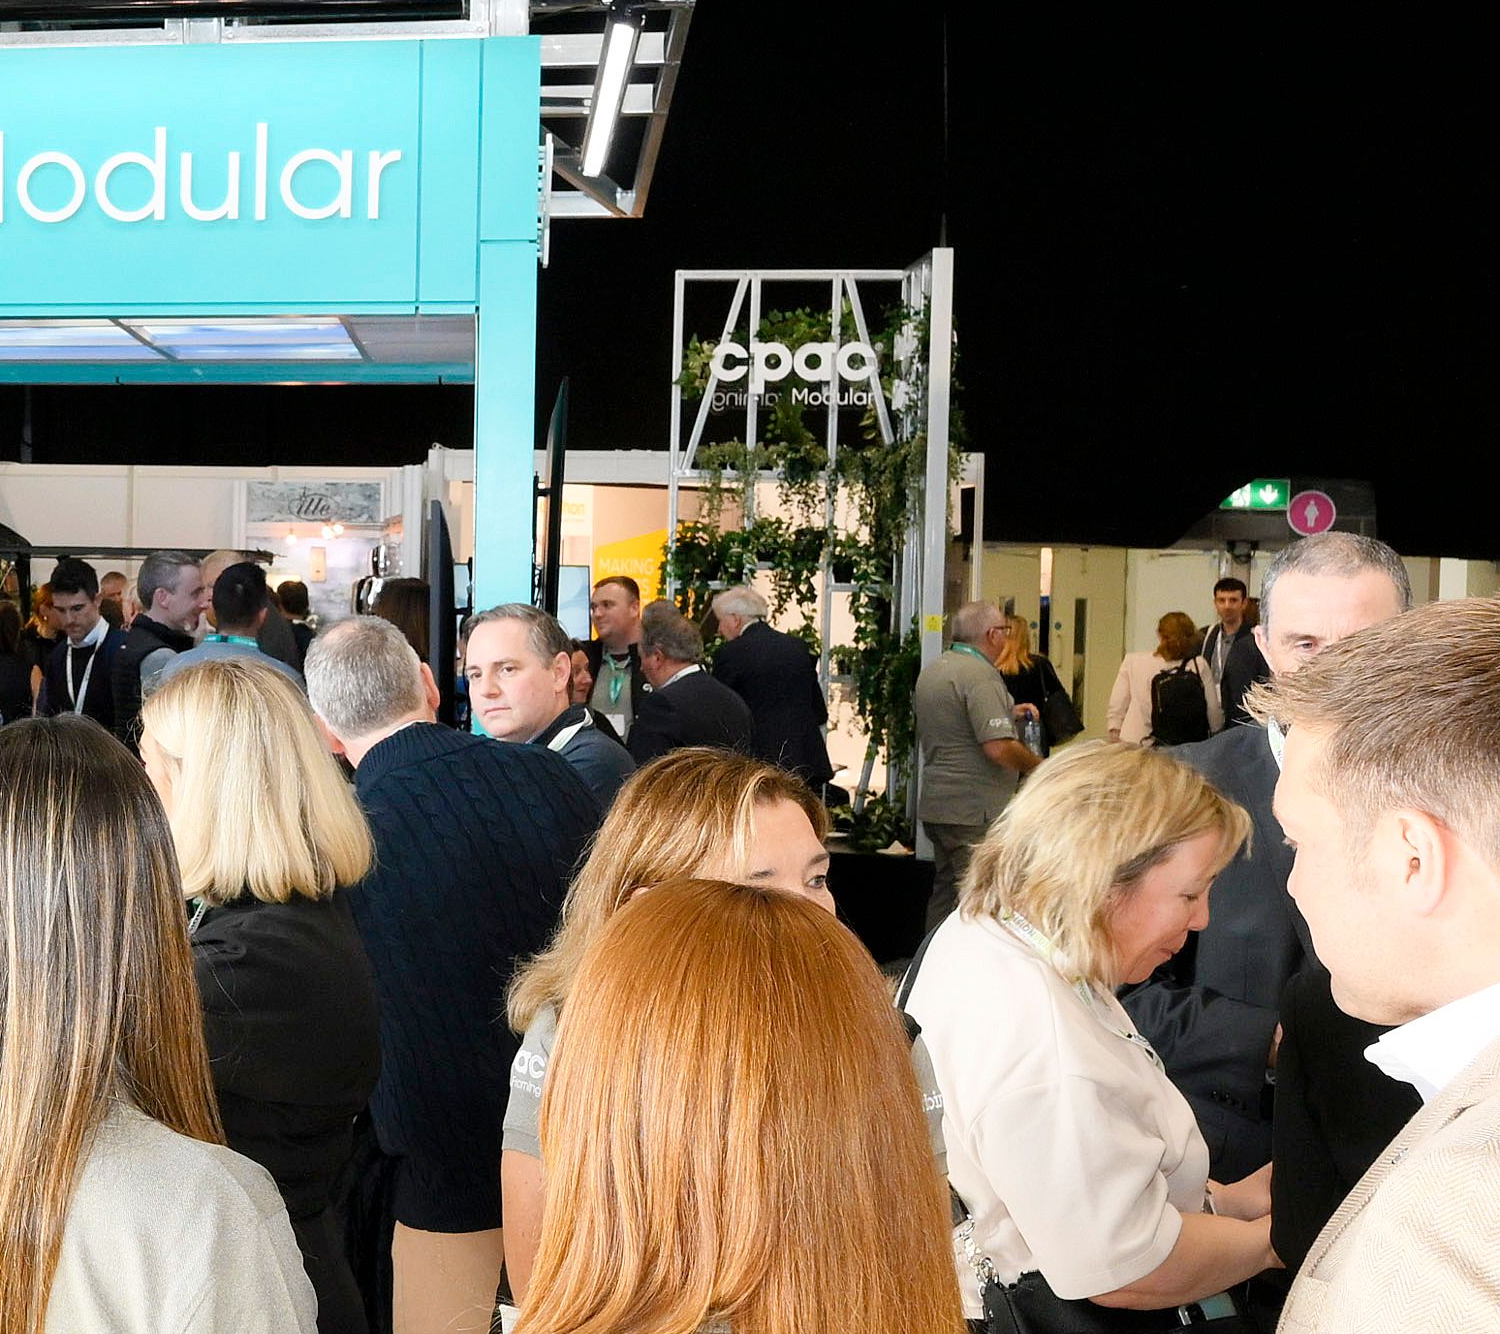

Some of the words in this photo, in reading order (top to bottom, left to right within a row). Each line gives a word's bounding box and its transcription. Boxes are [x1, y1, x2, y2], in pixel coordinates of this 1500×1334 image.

[710, 341, 878, 394] cpac
[296, 494, 330, 516] ille
[600, 558, 654, 575] MAKING
